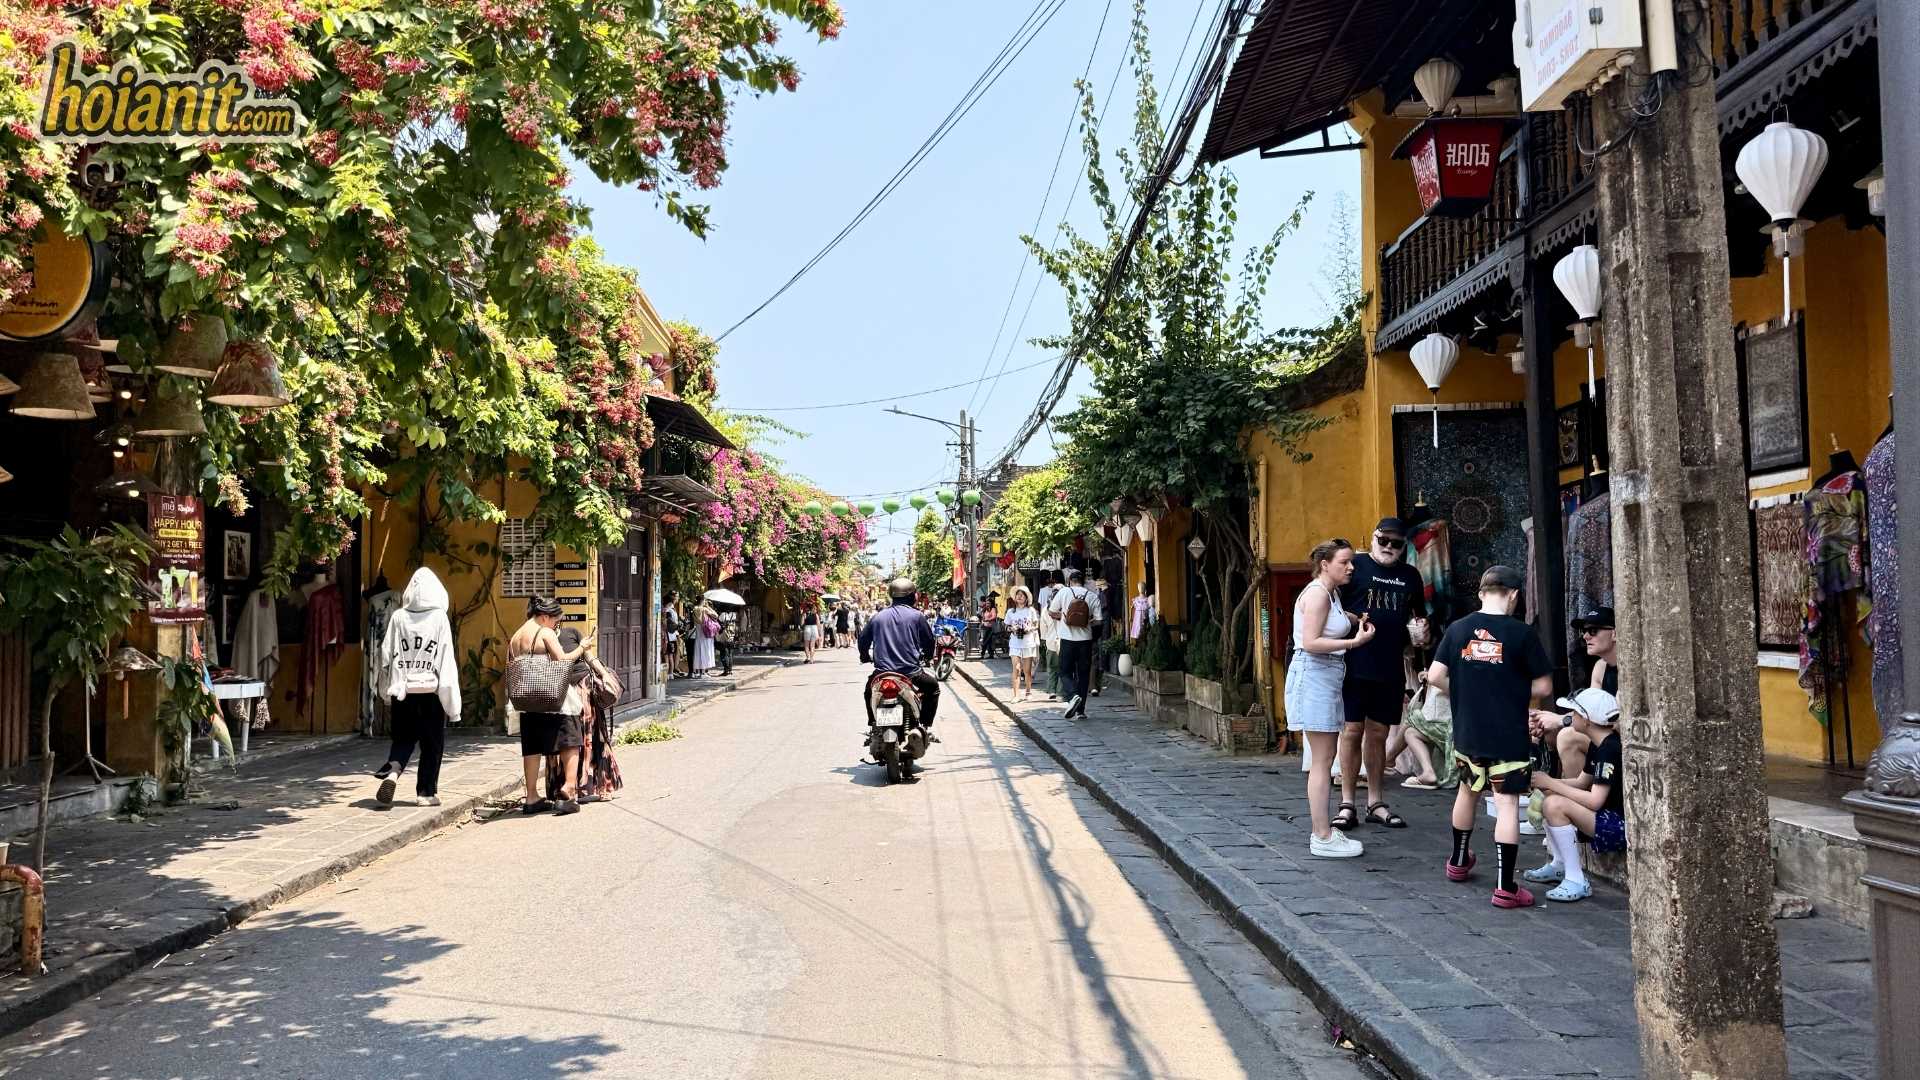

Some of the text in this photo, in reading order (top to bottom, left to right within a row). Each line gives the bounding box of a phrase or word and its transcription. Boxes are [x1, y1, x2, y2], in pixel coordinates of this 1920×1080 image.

[154, 517, 202, 530] HAPPY HOUR
[189, 541, 203, 549] FREE
